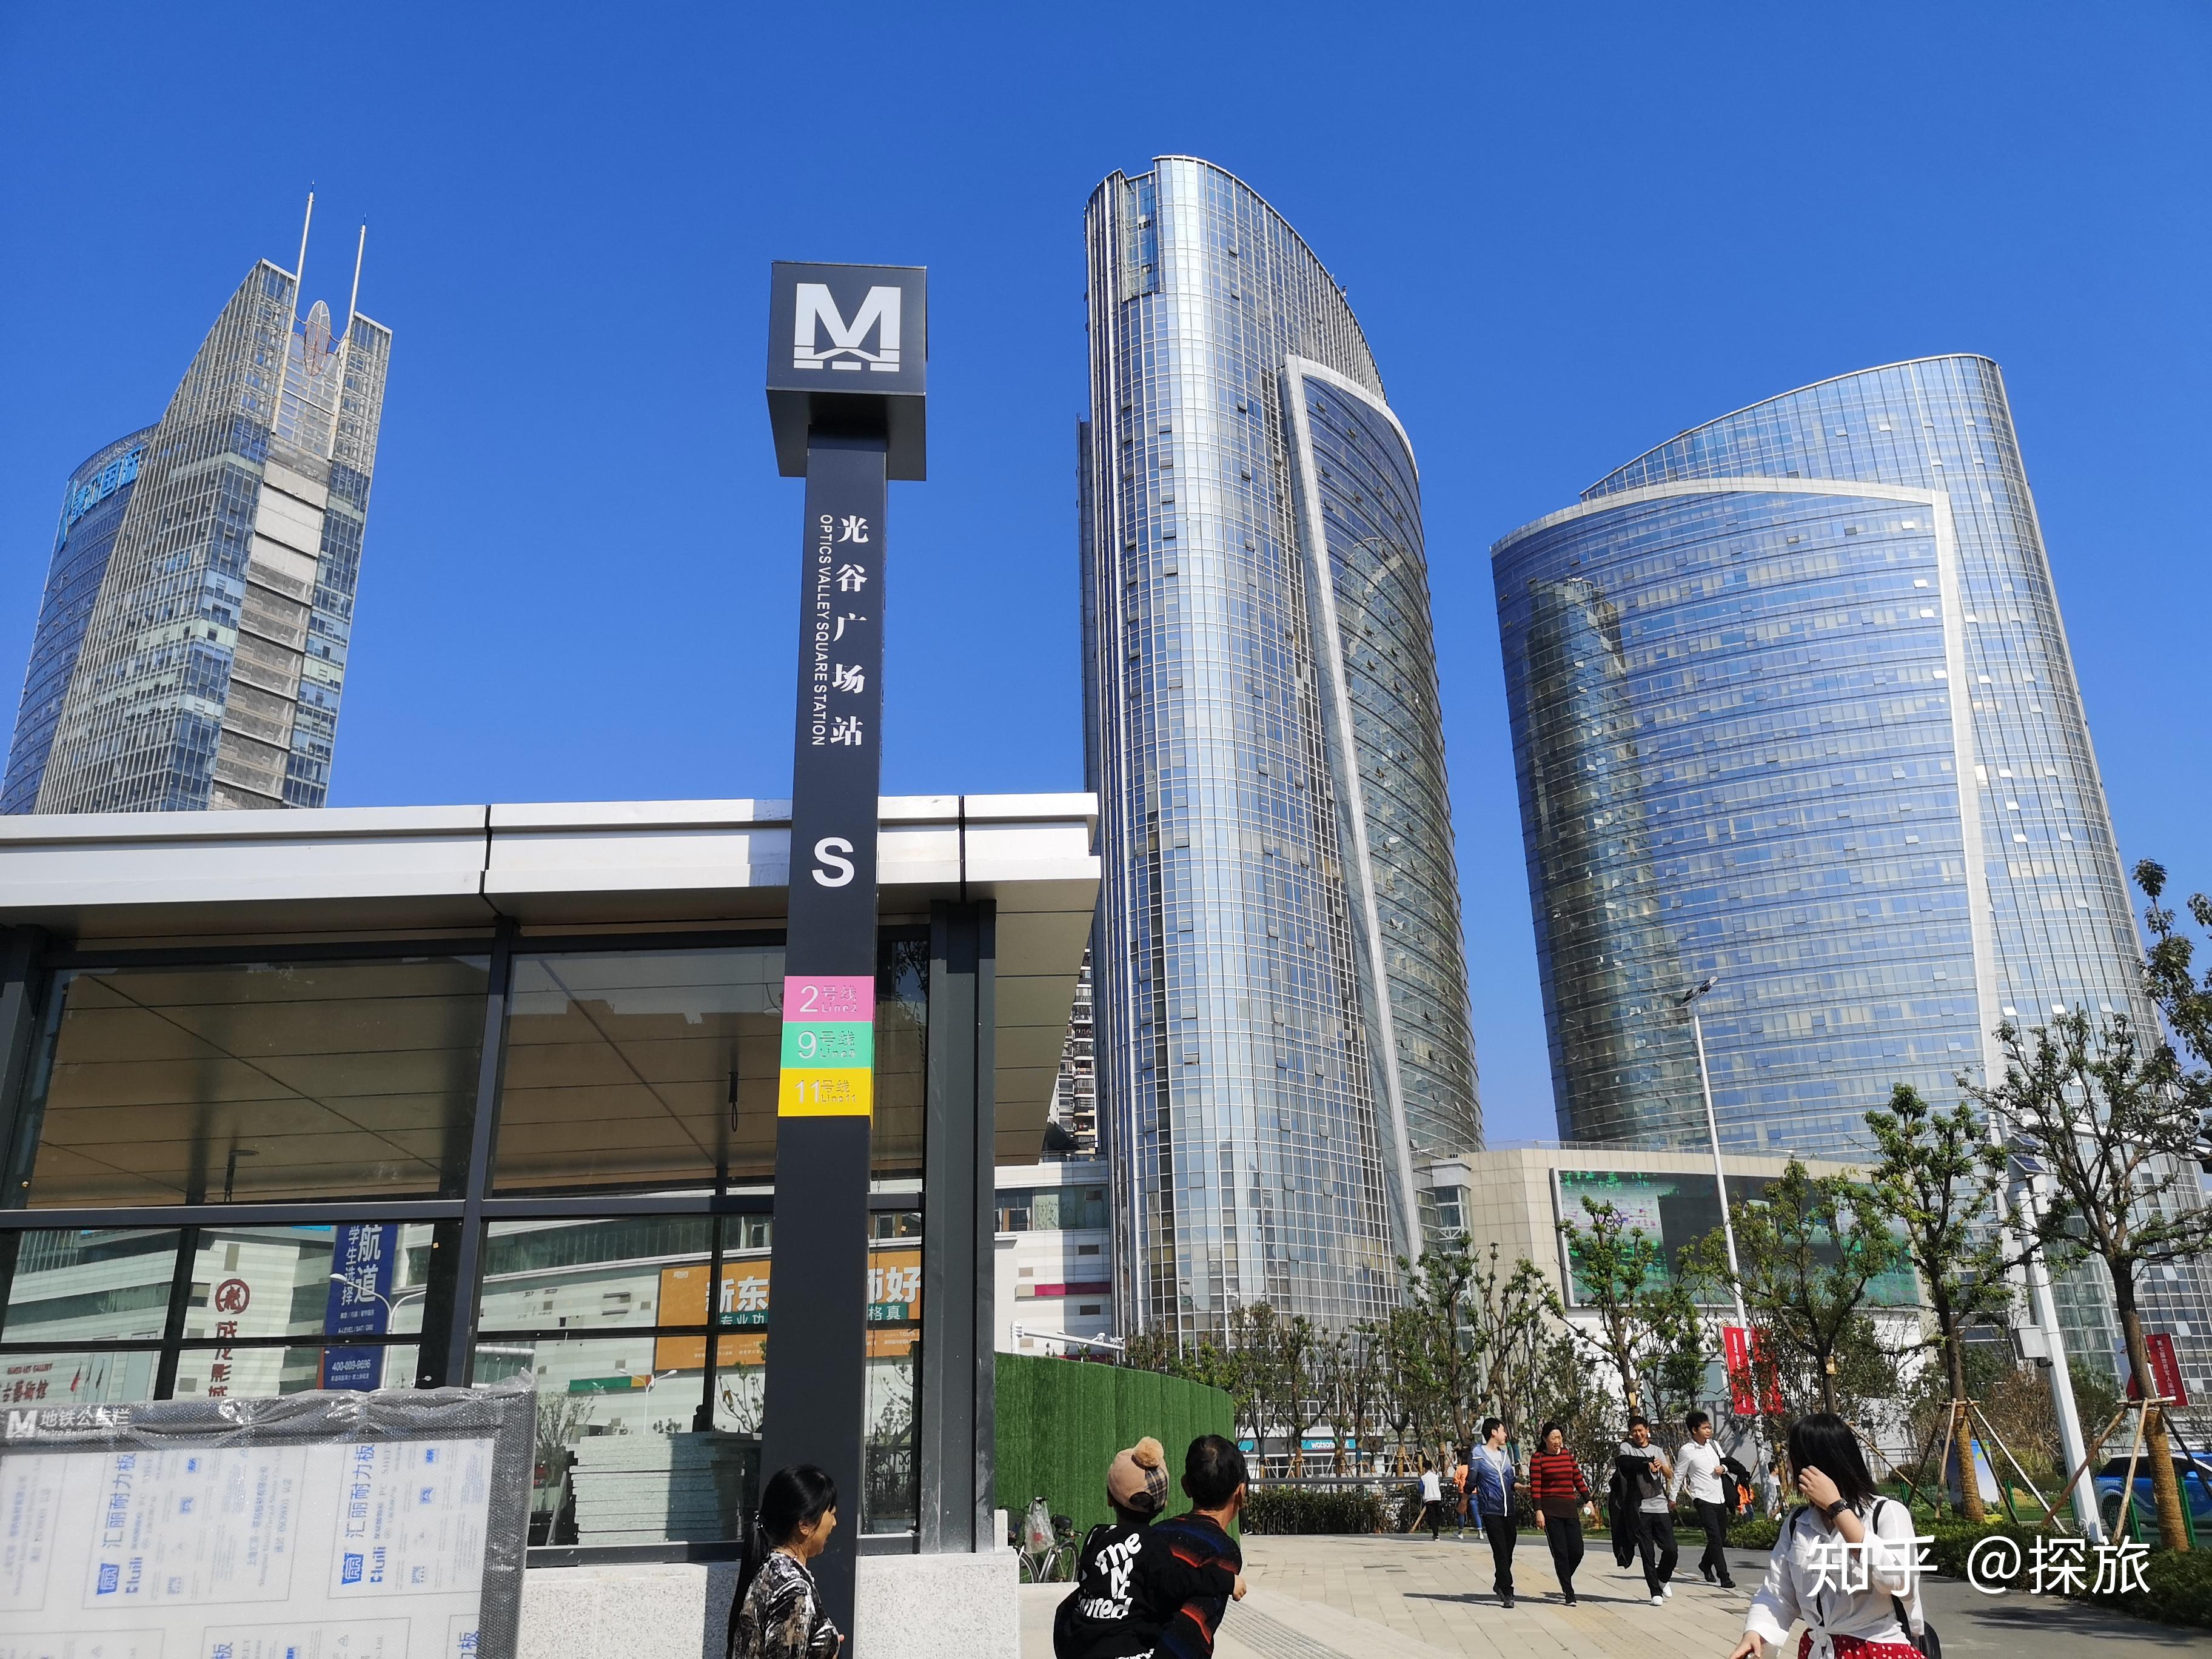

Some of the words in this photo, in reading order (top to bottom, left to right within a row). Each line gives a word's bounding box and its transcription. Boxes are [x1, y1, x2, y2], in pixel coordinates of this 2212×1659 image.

[818, 514, 833, 564] OPTICS
[816, 566, 831, 620] VALLEY
[814, 622, 829, 681] SQUARE
[830, 515, 869, 746] 光谷广场站
[812, 685, 827, 745] STATION
[812, 837, 855, 887] S
[822, 1002, 857, 1013] Line2
[341, 1225, 360, 1306] 学生选择
[354, 1224, 383, 1304] 航道
[38, 1429, 64, 1437] Metro
[65, 1427, 99, 1436] Bulletin
[101, 1426, 128, 1435] Board
[39, 1407, 129, 1427] 地铁公告栏
[102, 1453, 136, 1548] 汇丽耐力板
[345, 1444, 375, 1538] 汇丽耐力板
